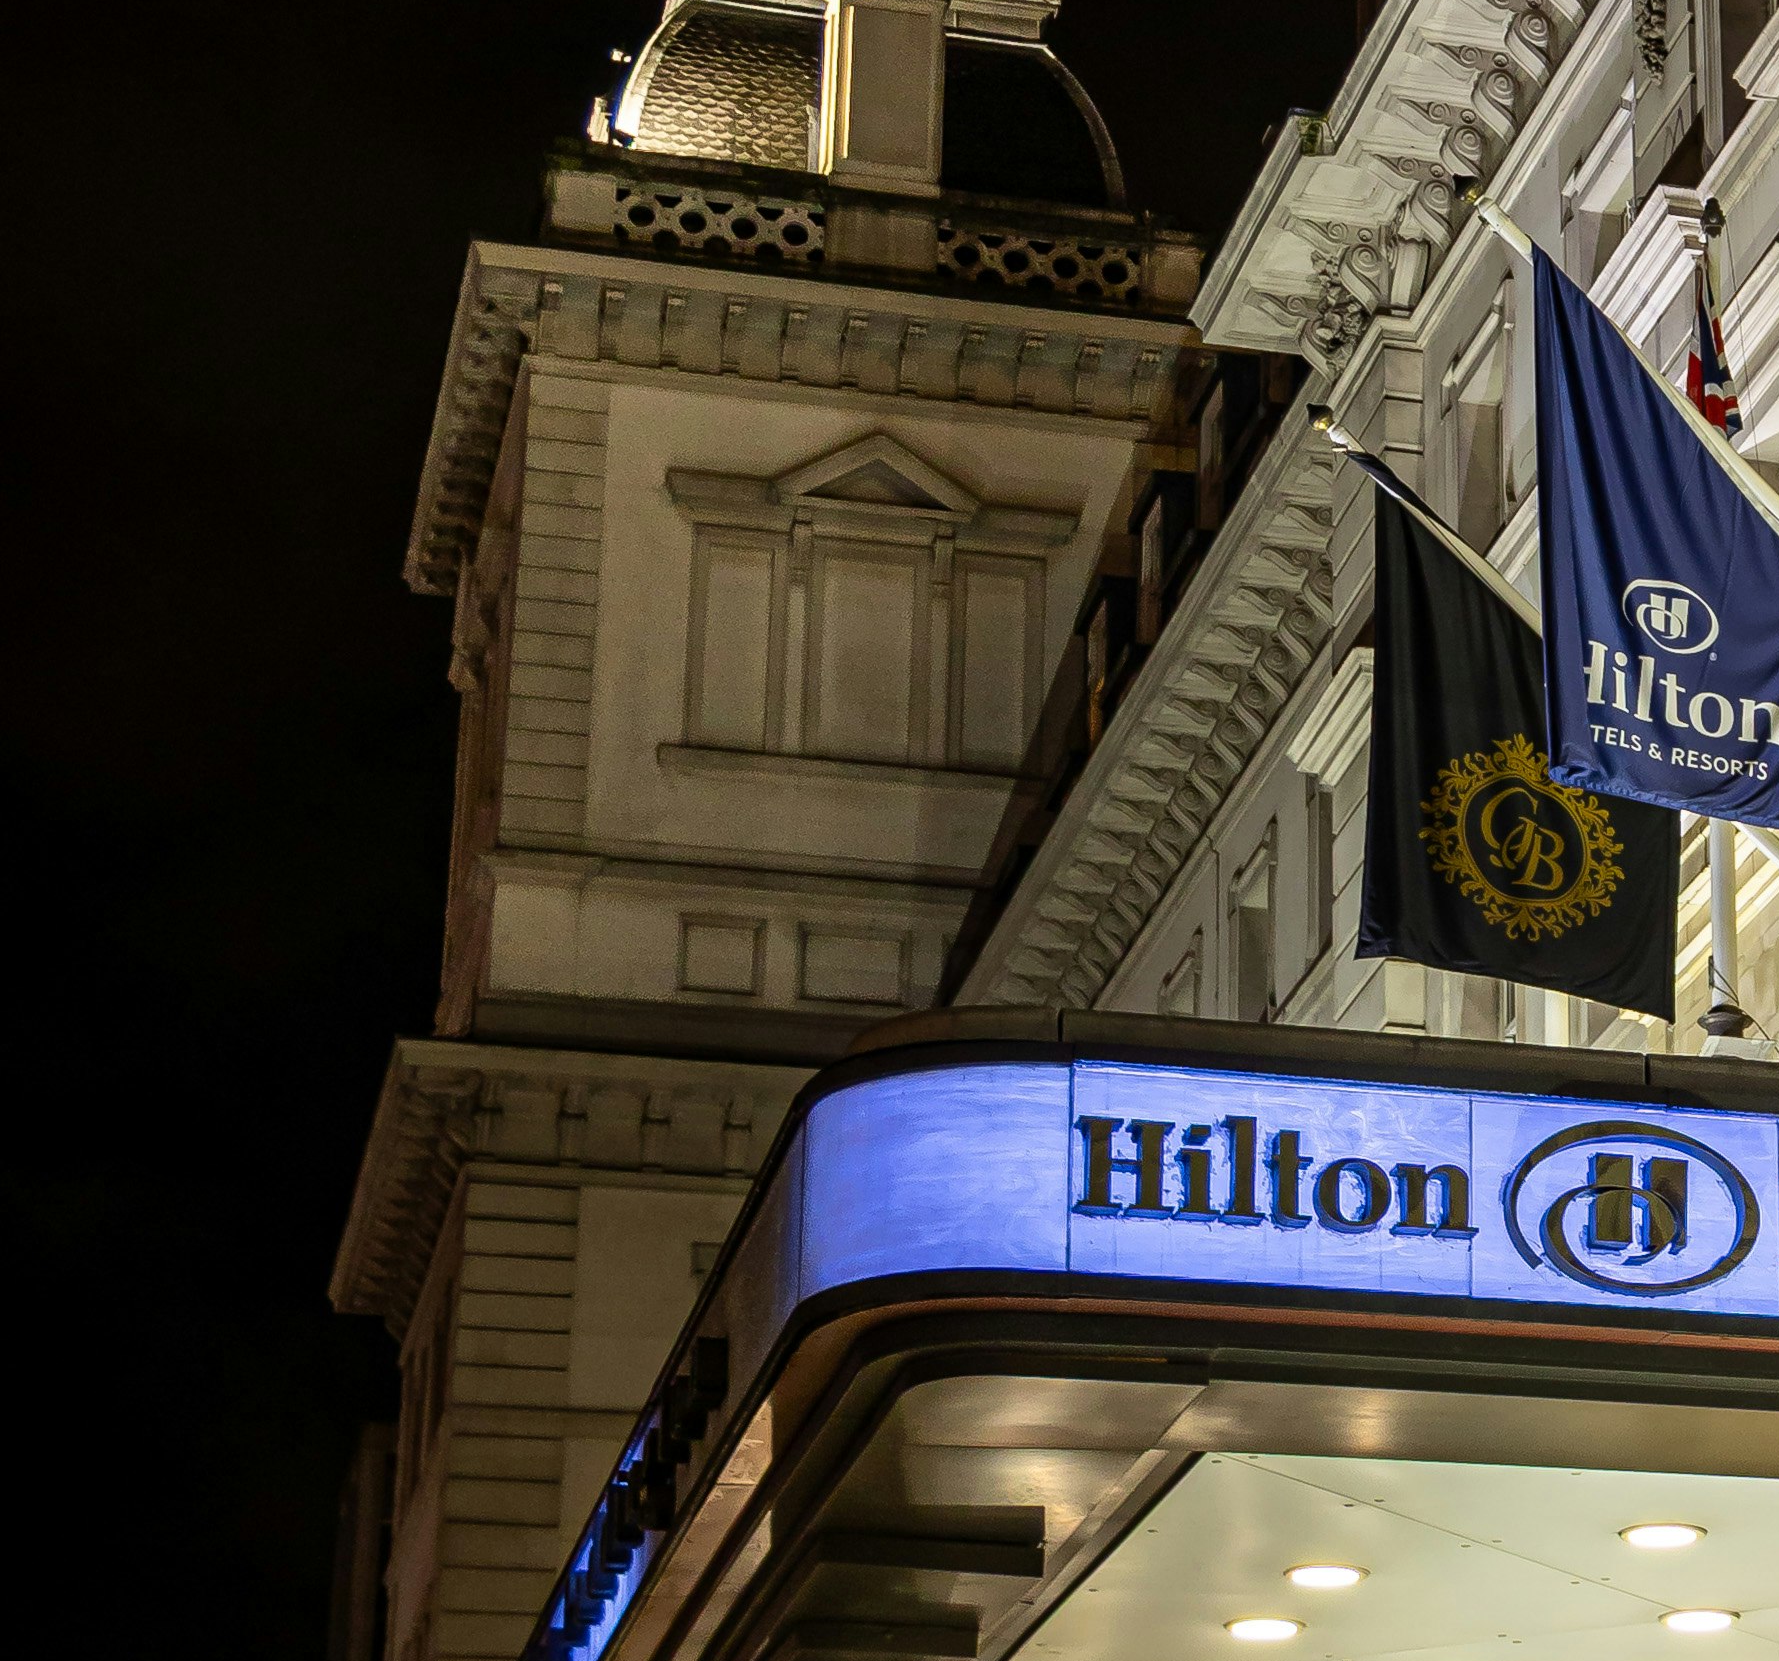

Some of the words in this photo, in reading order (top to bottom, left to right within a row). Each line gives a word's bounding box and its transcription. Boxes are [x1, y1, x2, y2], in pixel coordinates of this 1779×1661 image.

[1589, 724, 1643, 753] TELS
[1647, 742, 1664, 762] &
[1670, 747, 1769, 781] RESORTS
[1072, 1114, 1480, 1240] Hilton
